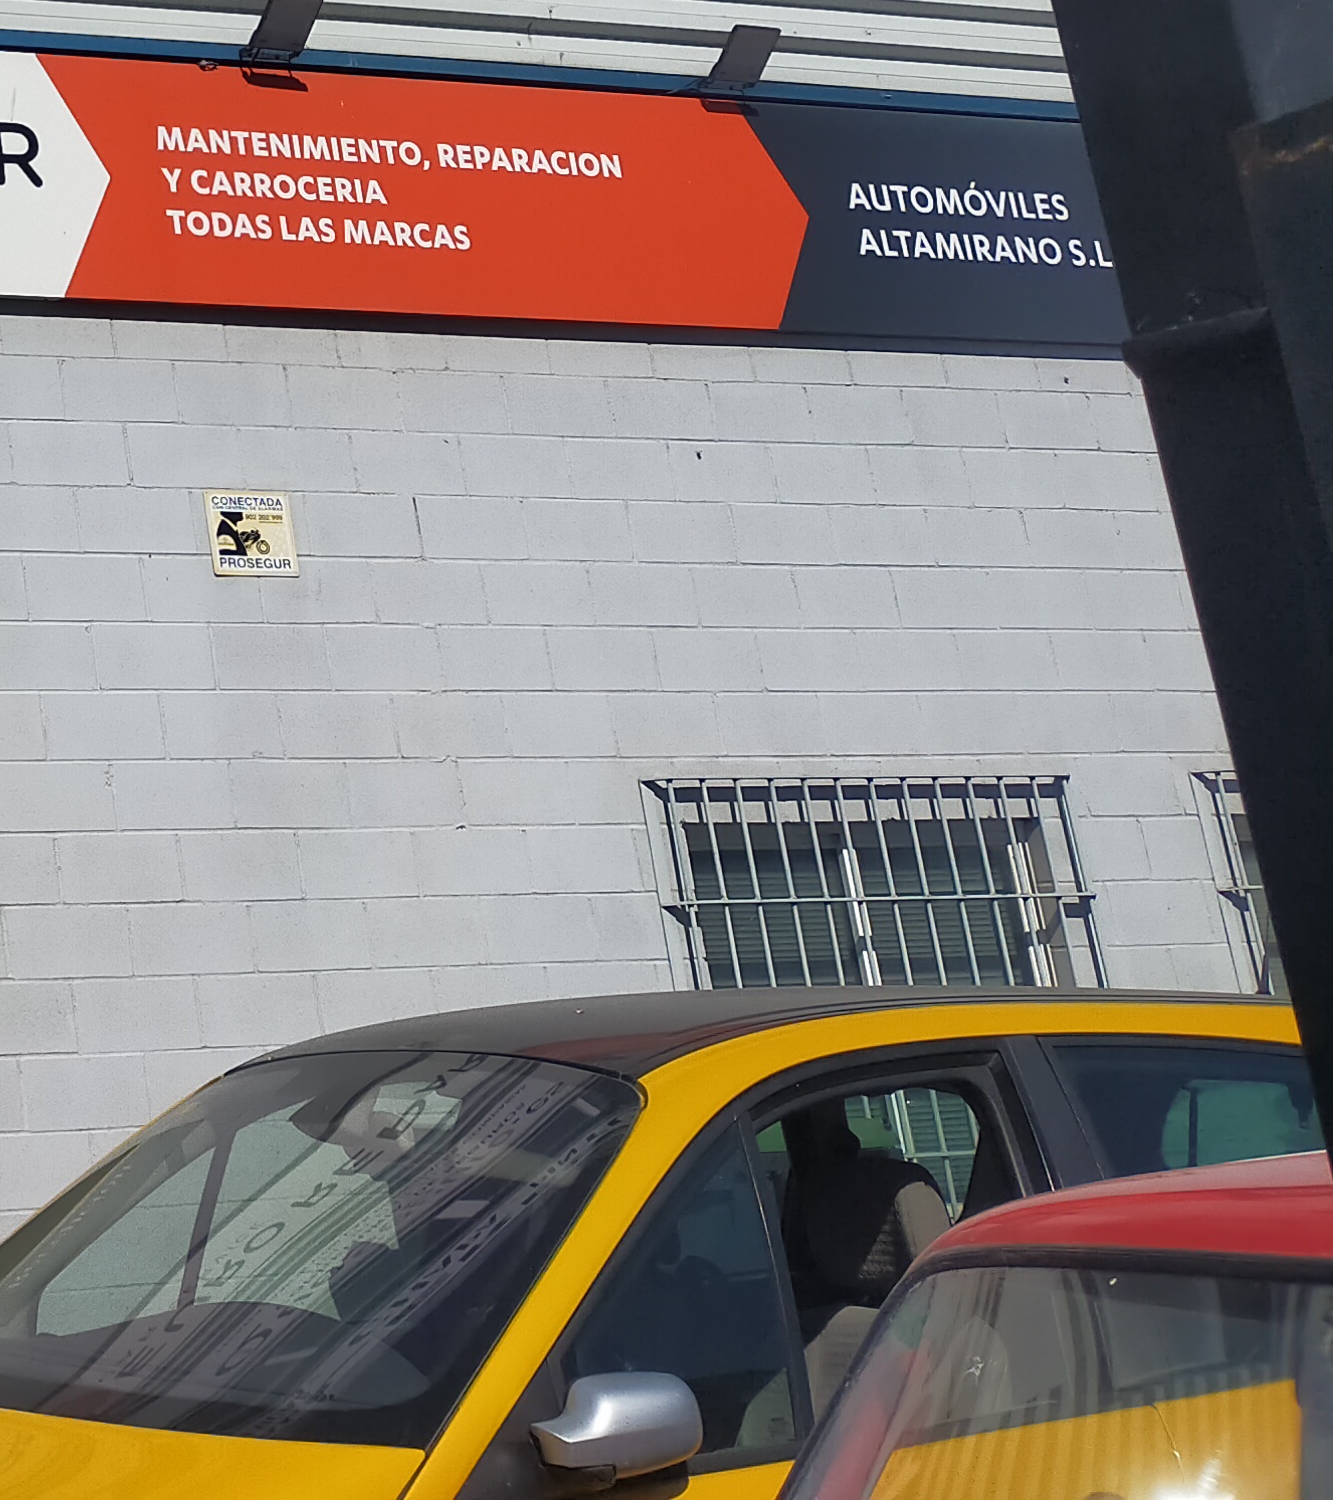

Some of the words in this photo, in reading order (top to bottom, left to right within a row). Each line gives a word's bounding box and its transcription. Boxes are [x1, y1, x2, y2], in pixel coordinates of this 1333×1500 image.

[155, 125, 431, 173] MANTENIMIENTO,
[439, 144, 623, 179] REPARACION
[162, 167, 181, 194] Y
[190, 169, 388, 205] CARROCERIA
[849, 181, 1070, 221] AUTOMÓVILES
[166, 209, 275, 241] TODAS
[278, 215, 336, 245] LAS
[343, 218, 472, 252] MARCAS
[860, 228, 1061, 266] ALTAMIRANO
[211, 496, 283, 507] CONECTADA
[220, 557, 291, 569] PROSEGUR
